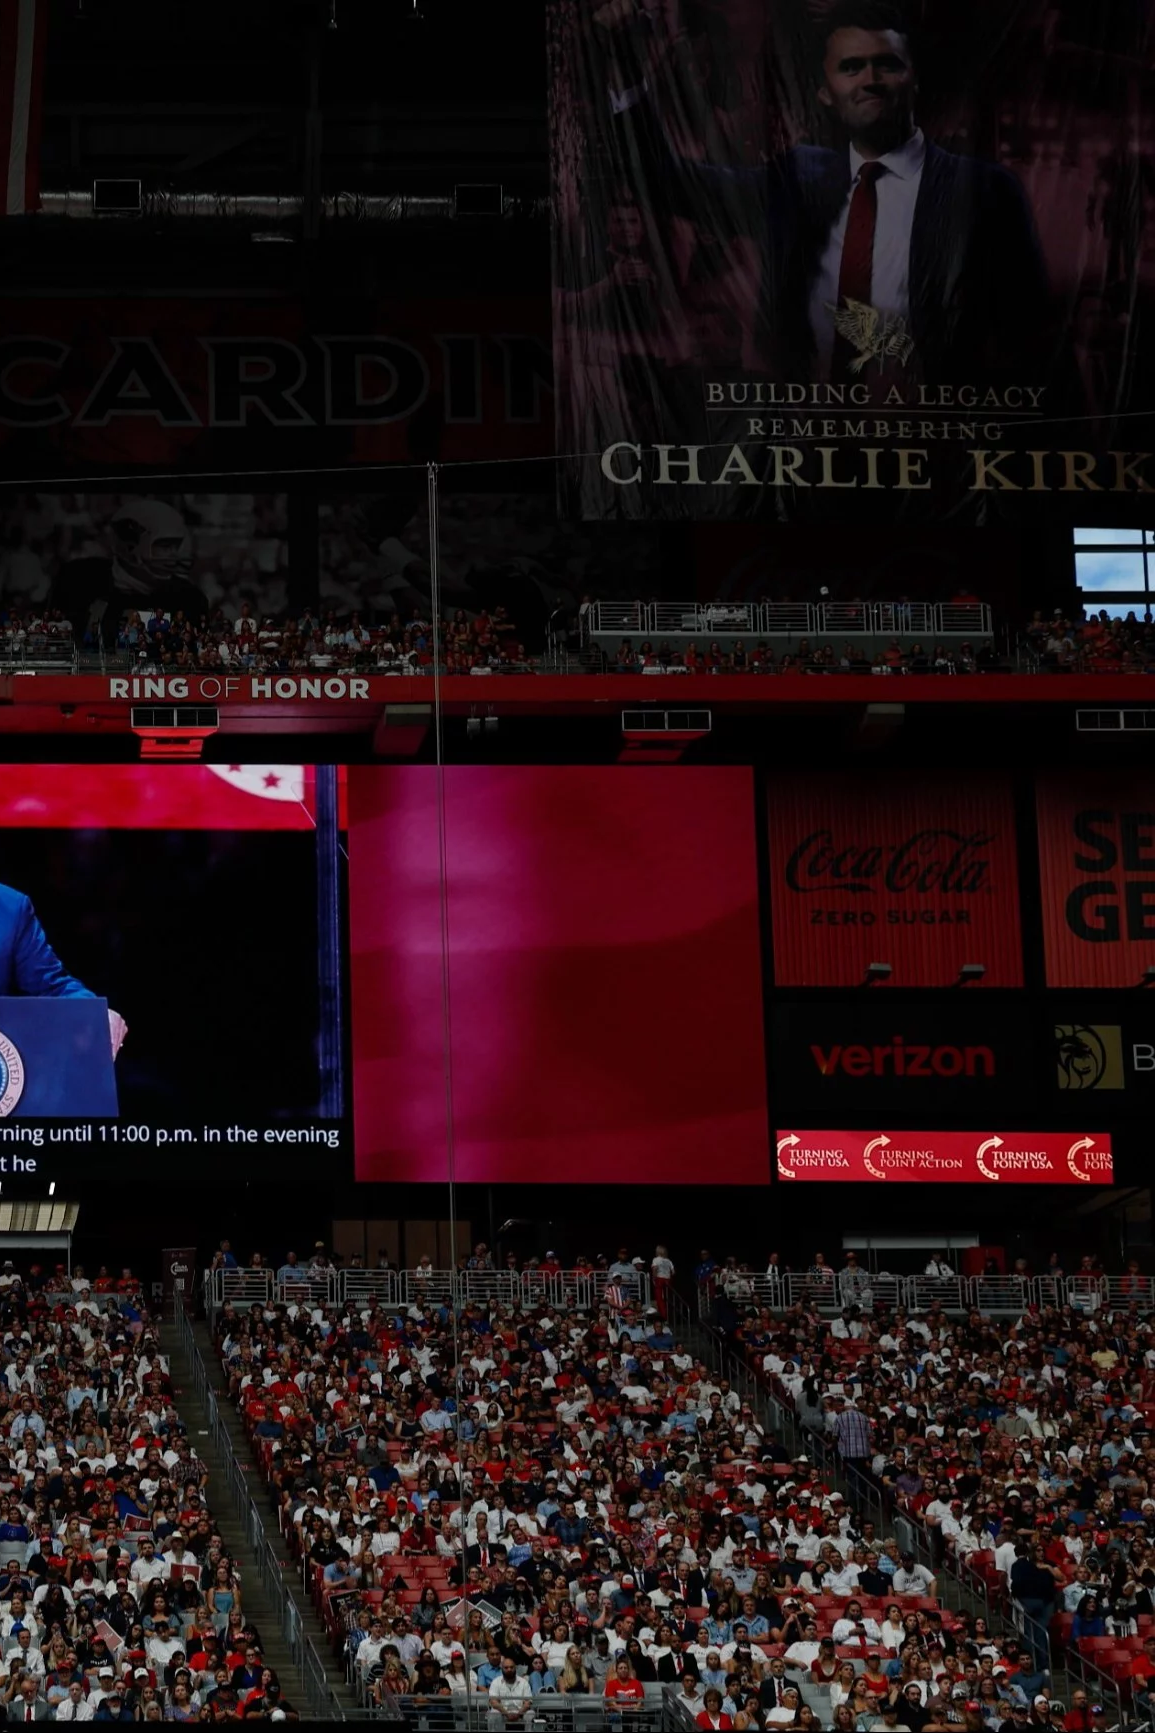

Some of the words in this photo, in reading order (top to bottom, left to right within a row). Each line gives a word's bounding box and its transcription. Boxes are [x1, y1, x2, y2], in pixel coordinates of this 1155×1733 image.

[706, 382, 870, 405] BUILDING
[883, 386, 905, 405] A
[918, 386, 1047, 408] LEGACY
[749, 418, 1003, 440] REMEMBERING
[601, 442, 931, 489] CHARLIE
[968, 448, 1155, 493] KIRK
[109, 677, 188, 699] RING
[199, 677, 240, 699] OF
[252, 677, 369, 699] HONOR
[810, 909, 876, 926] ZERO
[887, 909, 971, 926] SUGAR
[809, 1033, 996, 1079] verizon
[49, 1124, 93, 1143] until
[98, 1125, 150, 1143] 11:00
[155, 1128, 198, 1147] p.m.
[203, 1125, 221, 1143] in
[226, 1125, 258, 1143] the
[263, 1126, 340, 1147] evening
[788, 1149, 843, 1159] TURNING
[789, 1157, 827, 1167] POINT
[828, 1158, 849, 1167] USA
[880, 1149, 934, 1159] TURNING
[992, 1151, 1047, 1161] TURNING
[12, 1155, 37, 1173] he
[880, 1158, 917, 1168] POINT
[918, 1159, 963, 1169] ACTION
[993, 1160, 1031, 1169] POINT
[1032, 1160, 1053, 1170] USA
